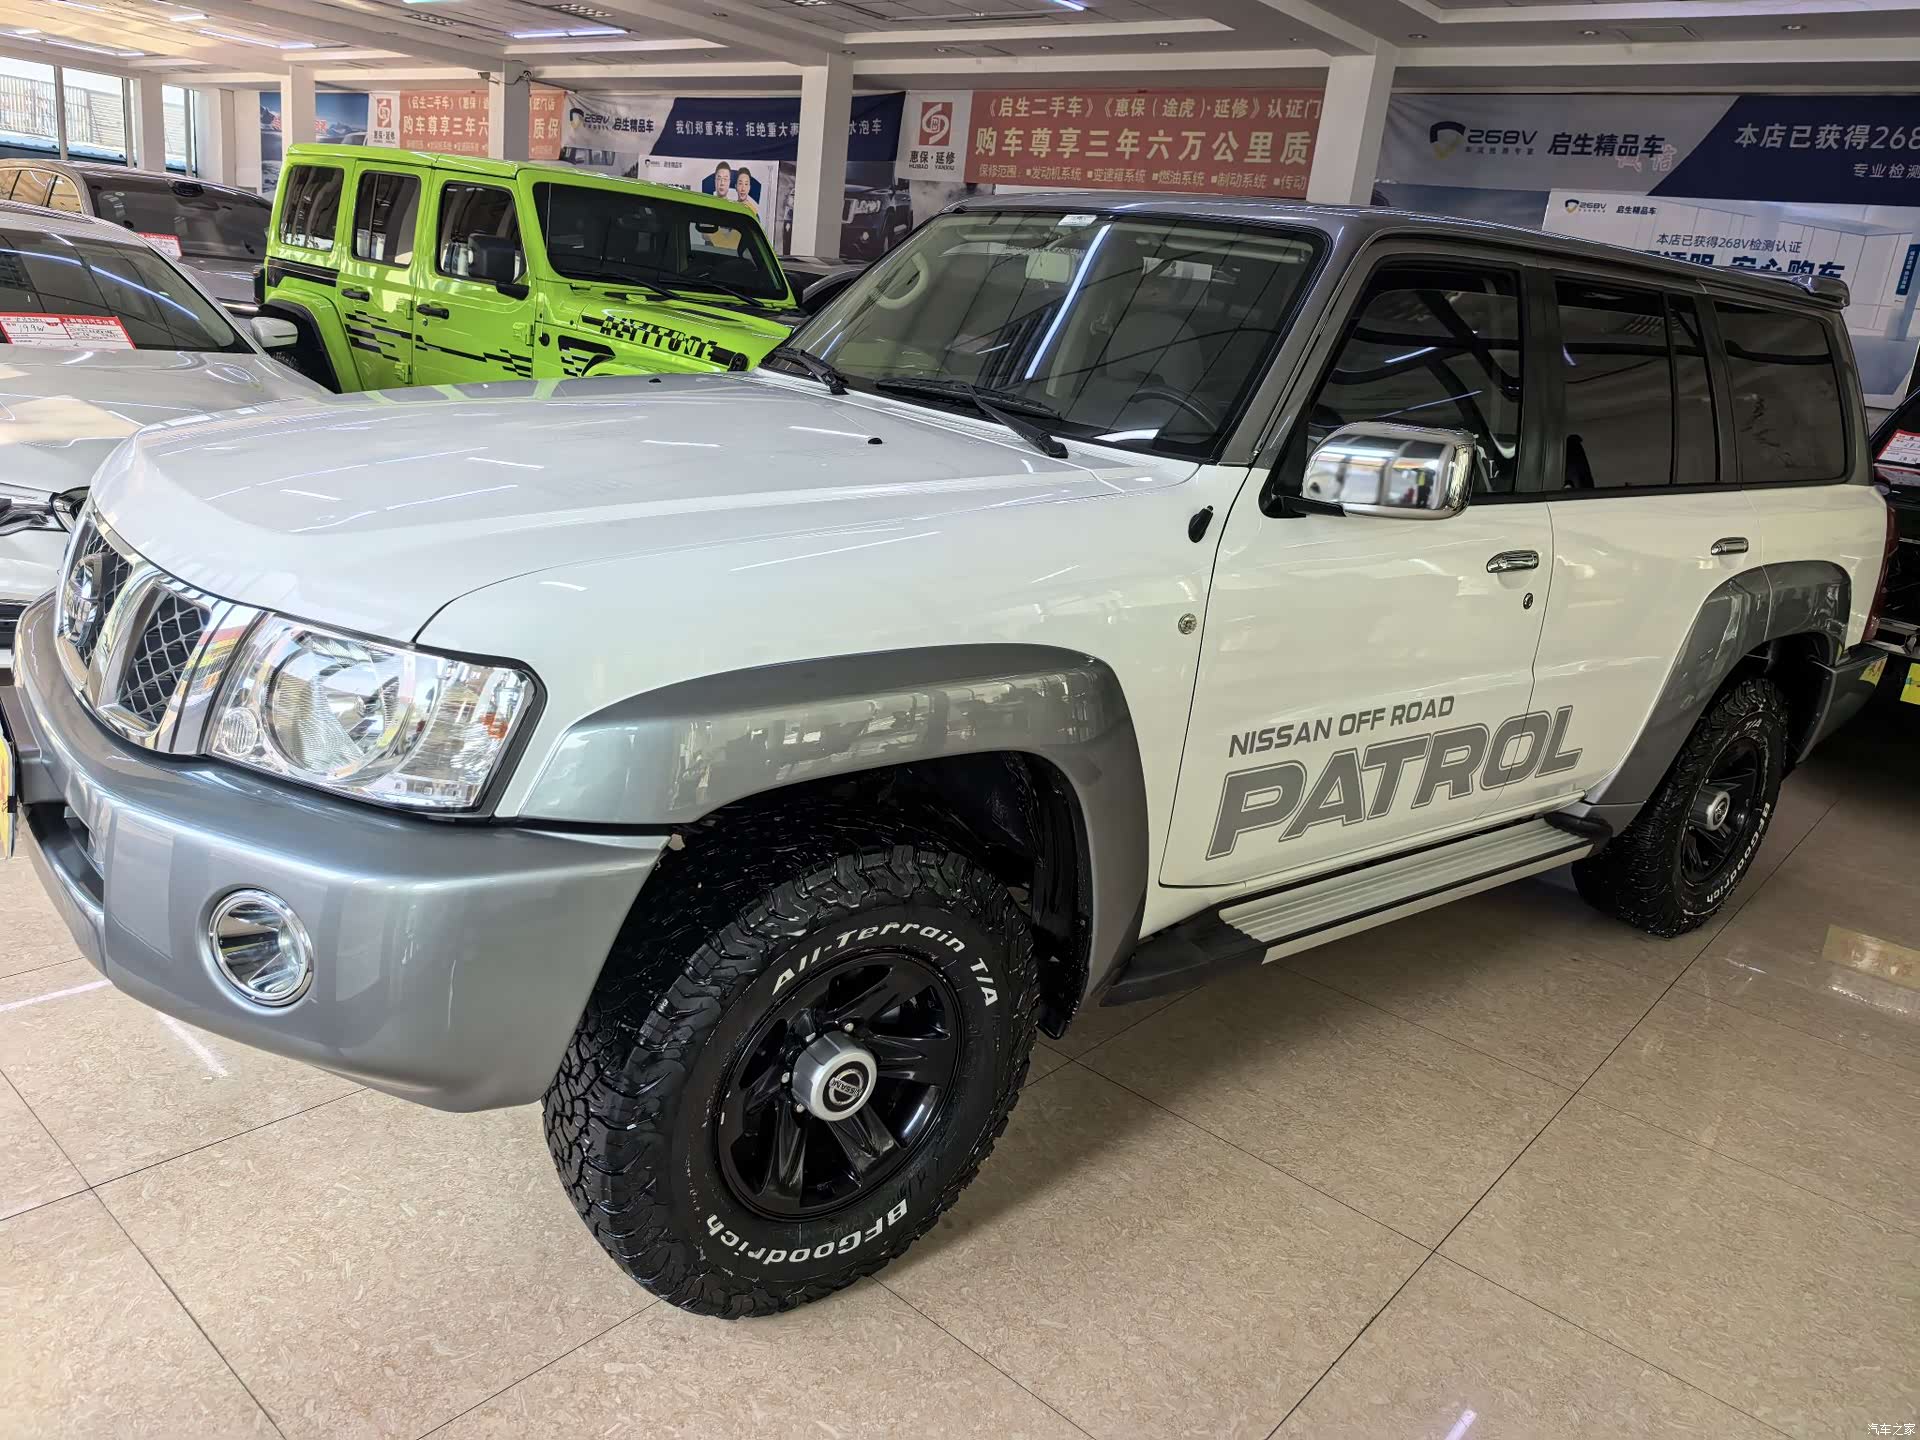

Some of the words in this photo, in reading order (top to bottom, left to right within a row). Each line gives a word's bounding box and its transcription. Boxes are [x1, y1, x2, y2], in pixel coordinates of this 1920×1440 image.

[403, 115, 488, 136] 购车尊享三年六
[534, 118, 560, 139] 质保
[976, 127, 1312, 165] 购车尊享三年六万公里质
[1467, 129, 1538, 145] 268V
[1548, 132, 1665, 158] 启生精品车
[1615, 206, 1657, 215] 启生精品车
[1656, 234, 1803, 254] 本店已获得268V检测认证
[1228, 716, 1333, 758] NISSAN
[1338, 707, 1386, 737] OFF
[1390, 695, 1455, 726] ROAD
[1205, 704, 1584, 861] PATROL
[1706, 802, 1771, 903] BFGoodrich
[771, 921, 966, 996] All-Terrain
[968, 957, 999, 1008] T/A
[705, 1198, 909, 1266] BFGoodrich
